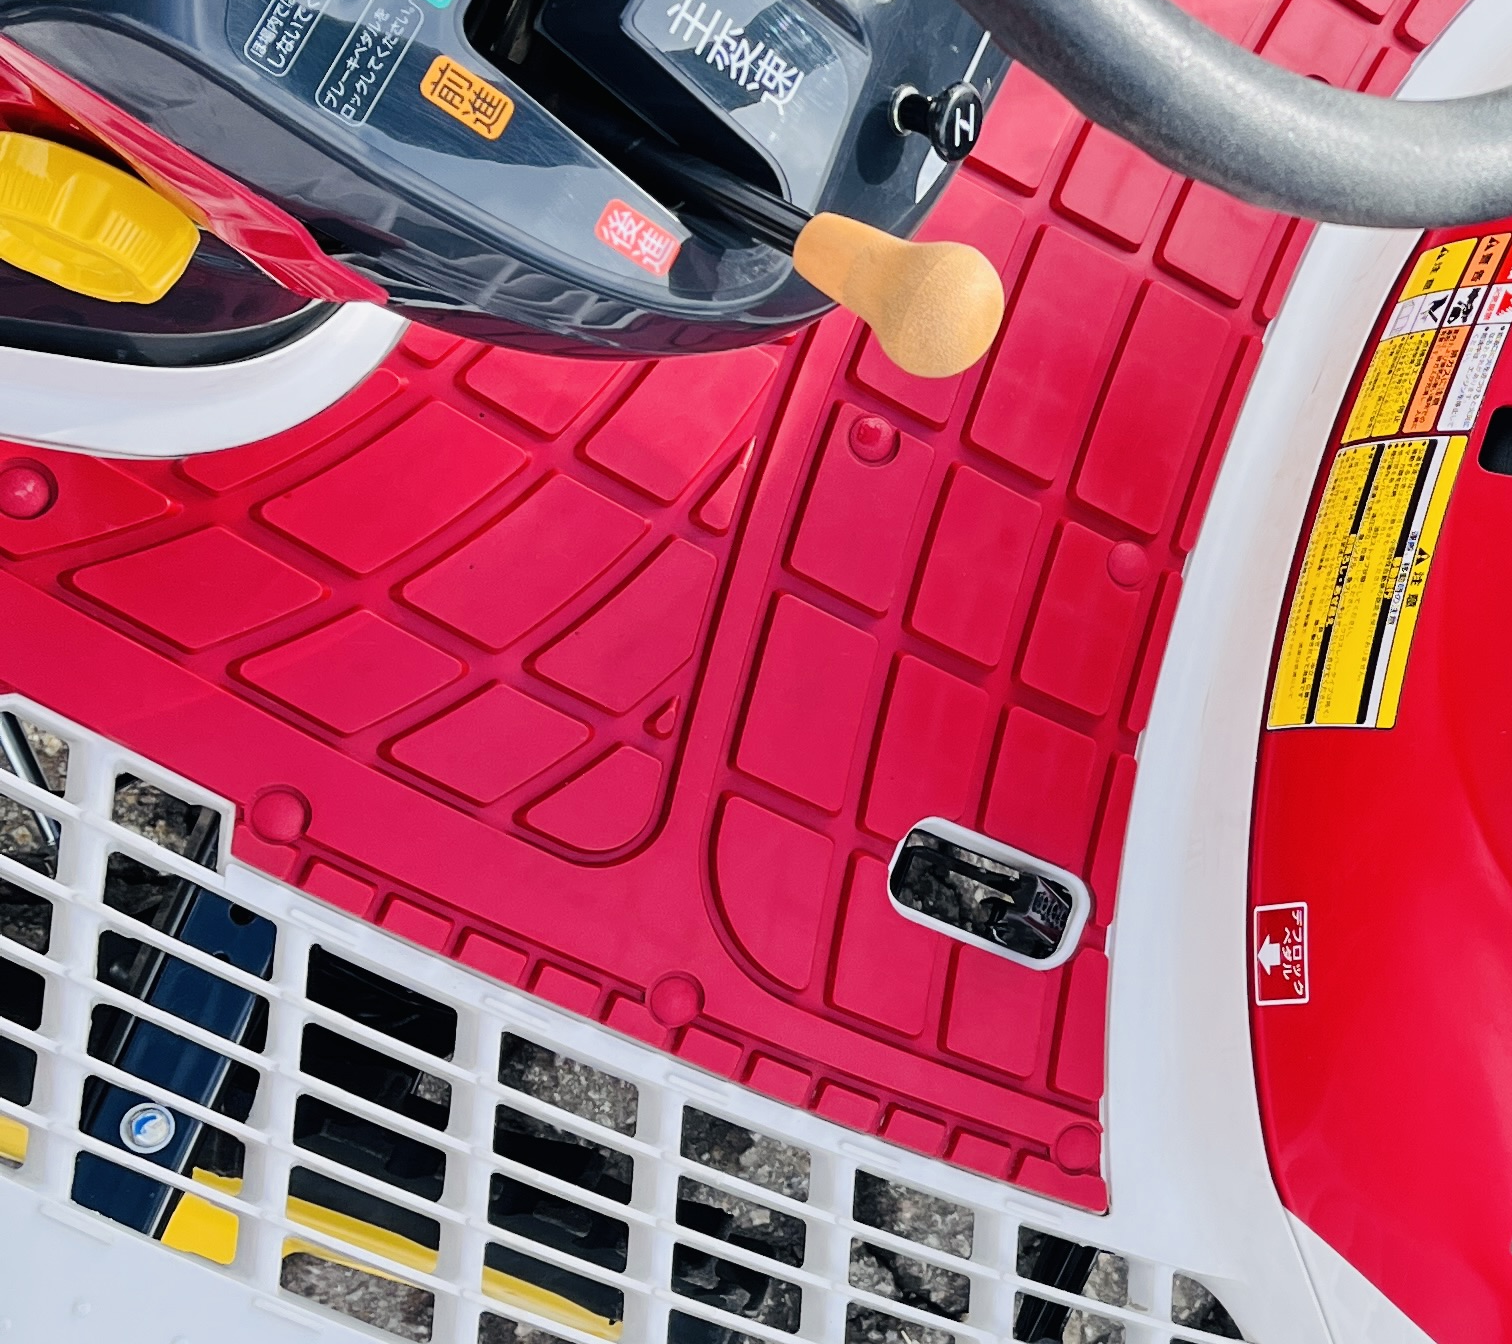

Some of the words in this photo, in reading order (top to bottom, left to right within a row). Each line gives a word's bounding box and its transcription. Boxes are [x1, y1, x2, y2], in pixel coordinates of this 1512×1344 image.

[322, 7, 392, 109] ブレーキペダルを
[340, 5, 416, 120] ロックしてください。
[429, 61, 509, 135] 前進
[602, 208, 675, 274] 後進
[1405, 571, 1427, 609] 注意
[1291, 908, 1304, 997] デフロック
